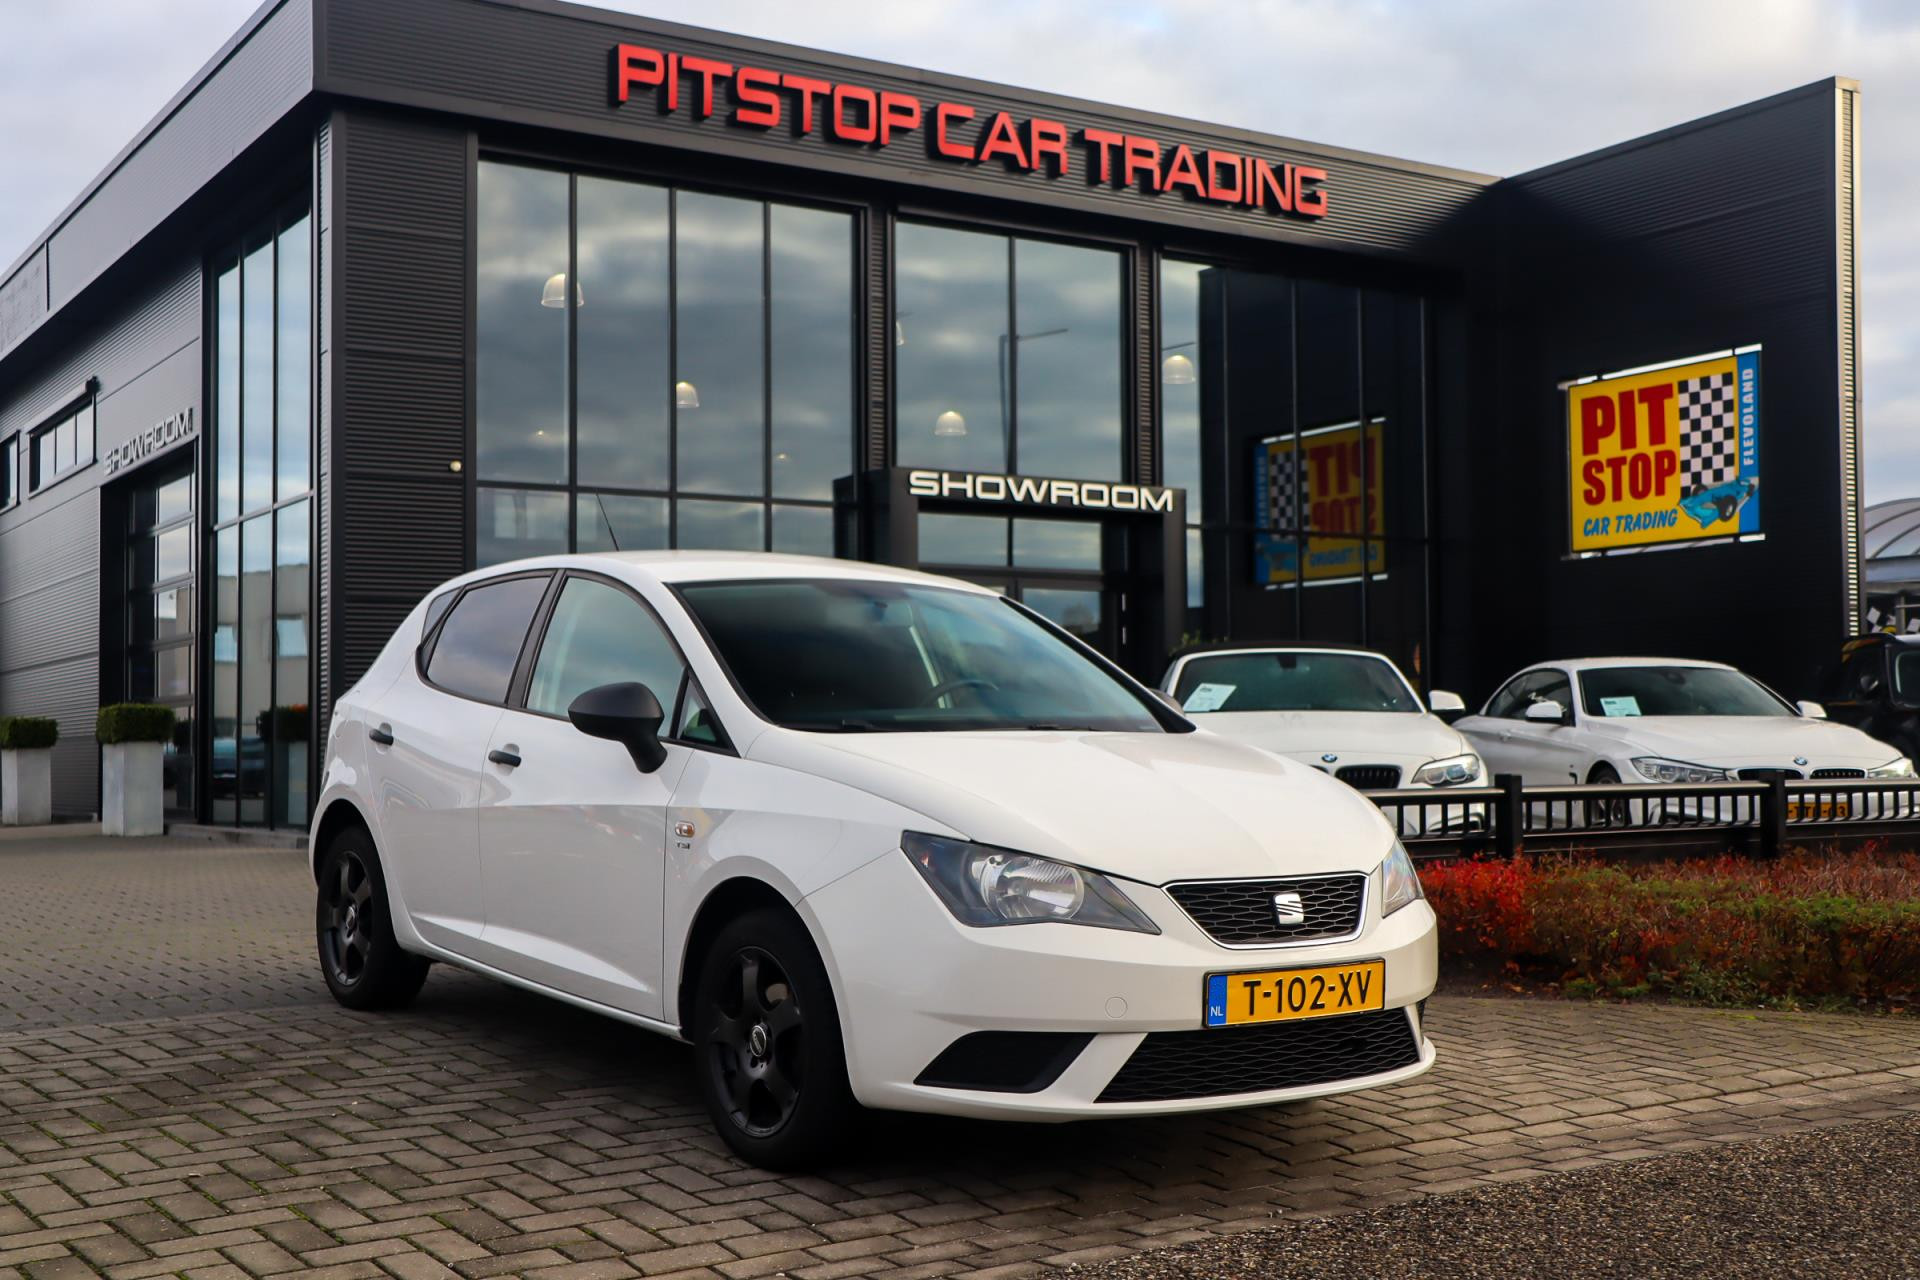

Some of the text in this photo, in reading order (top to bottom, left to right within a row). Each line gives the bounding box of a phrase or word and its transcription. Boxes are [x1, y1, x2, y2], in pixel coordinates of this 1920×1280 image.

[617, 43, 1329, 218] PITSTOP CAR TRADING
[103, 407, 192, 477] SHOWROOM
[1581, 383, 1674, 456] PIT
[1742, 368, 1754, 466] FLEVOLAND
[909, 470, 1173, 512] SHOWROOM
[1582, 449, 1677, 506] STOP
[1583, 508, 1678, 537] CAR TRADING
[1210, 1005, 1224, 1017] NL
[1243, 969, 1372, 1016] T-102-XV
